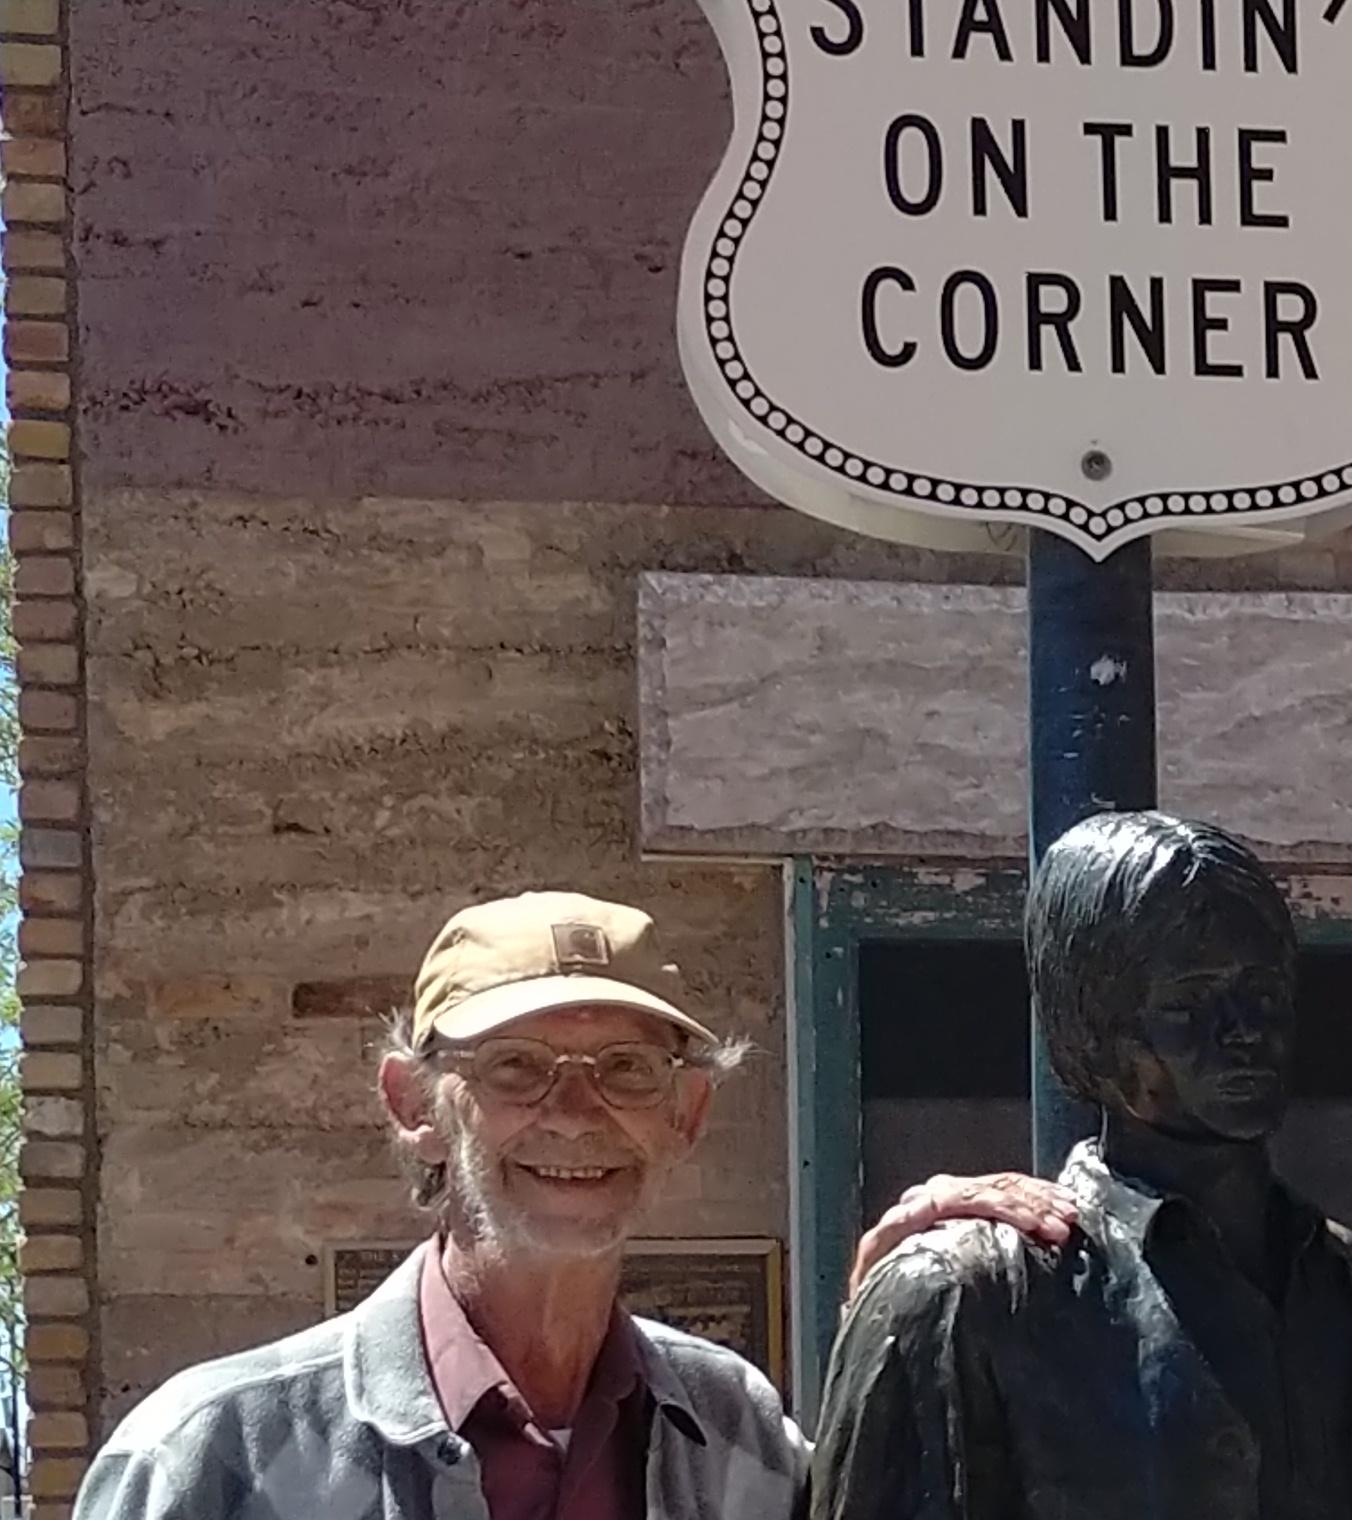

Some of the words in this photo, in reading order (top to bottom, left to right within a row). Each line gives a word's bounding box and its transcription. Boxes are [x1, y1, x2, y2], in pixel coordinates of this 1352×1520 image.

[883, 114, 1029, 219] ON
[1083, 121, 1291, 229] THE
[860, 266, 1320, 381] CORNER
